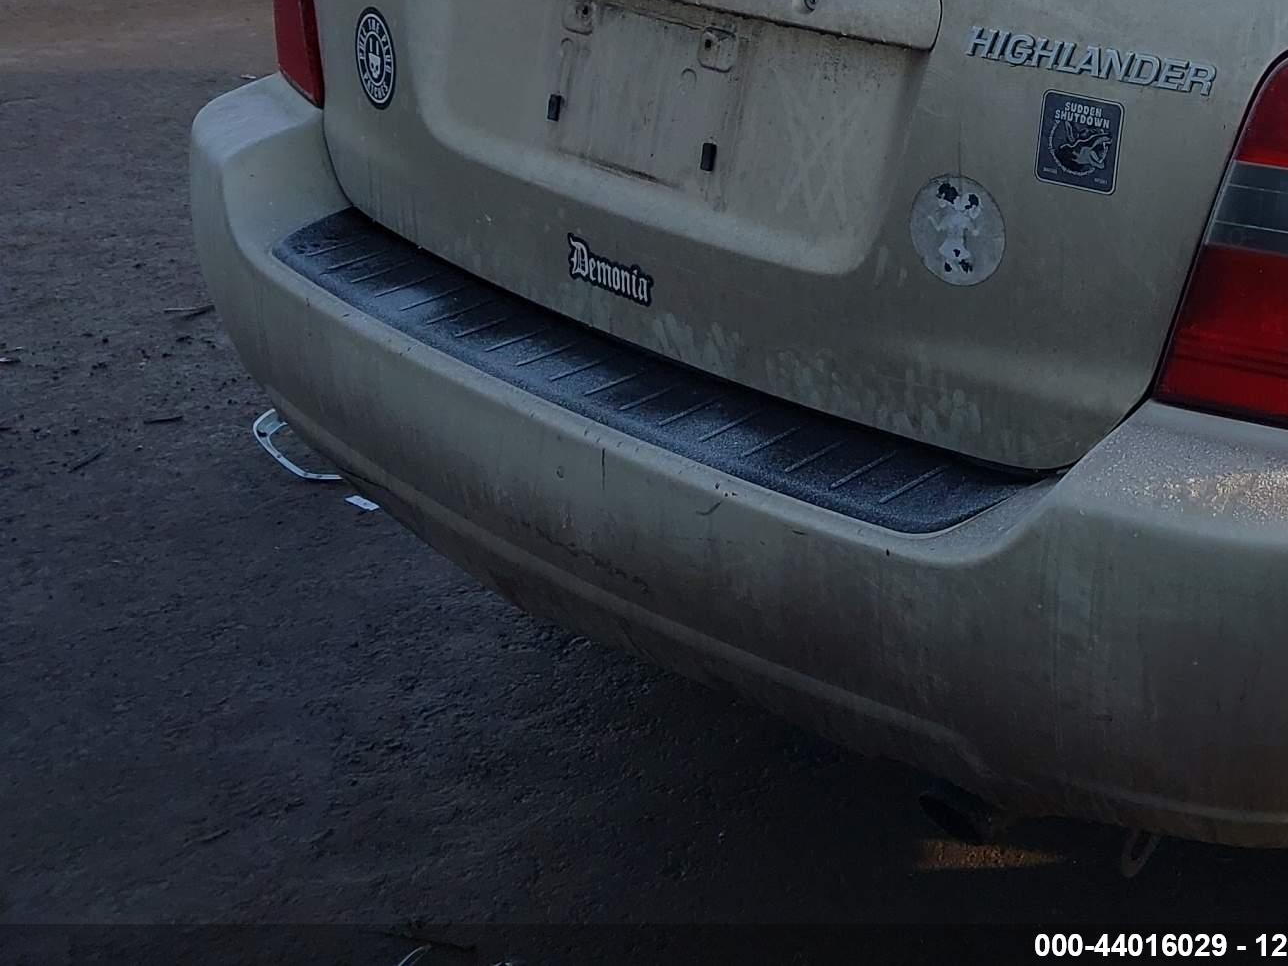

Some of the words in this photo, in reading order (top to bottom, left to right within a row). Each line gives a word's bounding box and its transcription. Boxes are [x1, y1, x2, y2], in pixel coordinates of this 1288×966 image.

[966, 25, 1217, 96] HIGHLANDER
[1054, 109, 1111, 130] SHUTDOWN
[1064, 101, 1103, 118] SUDDEN
[569, 236, 649, 303] Demonia
